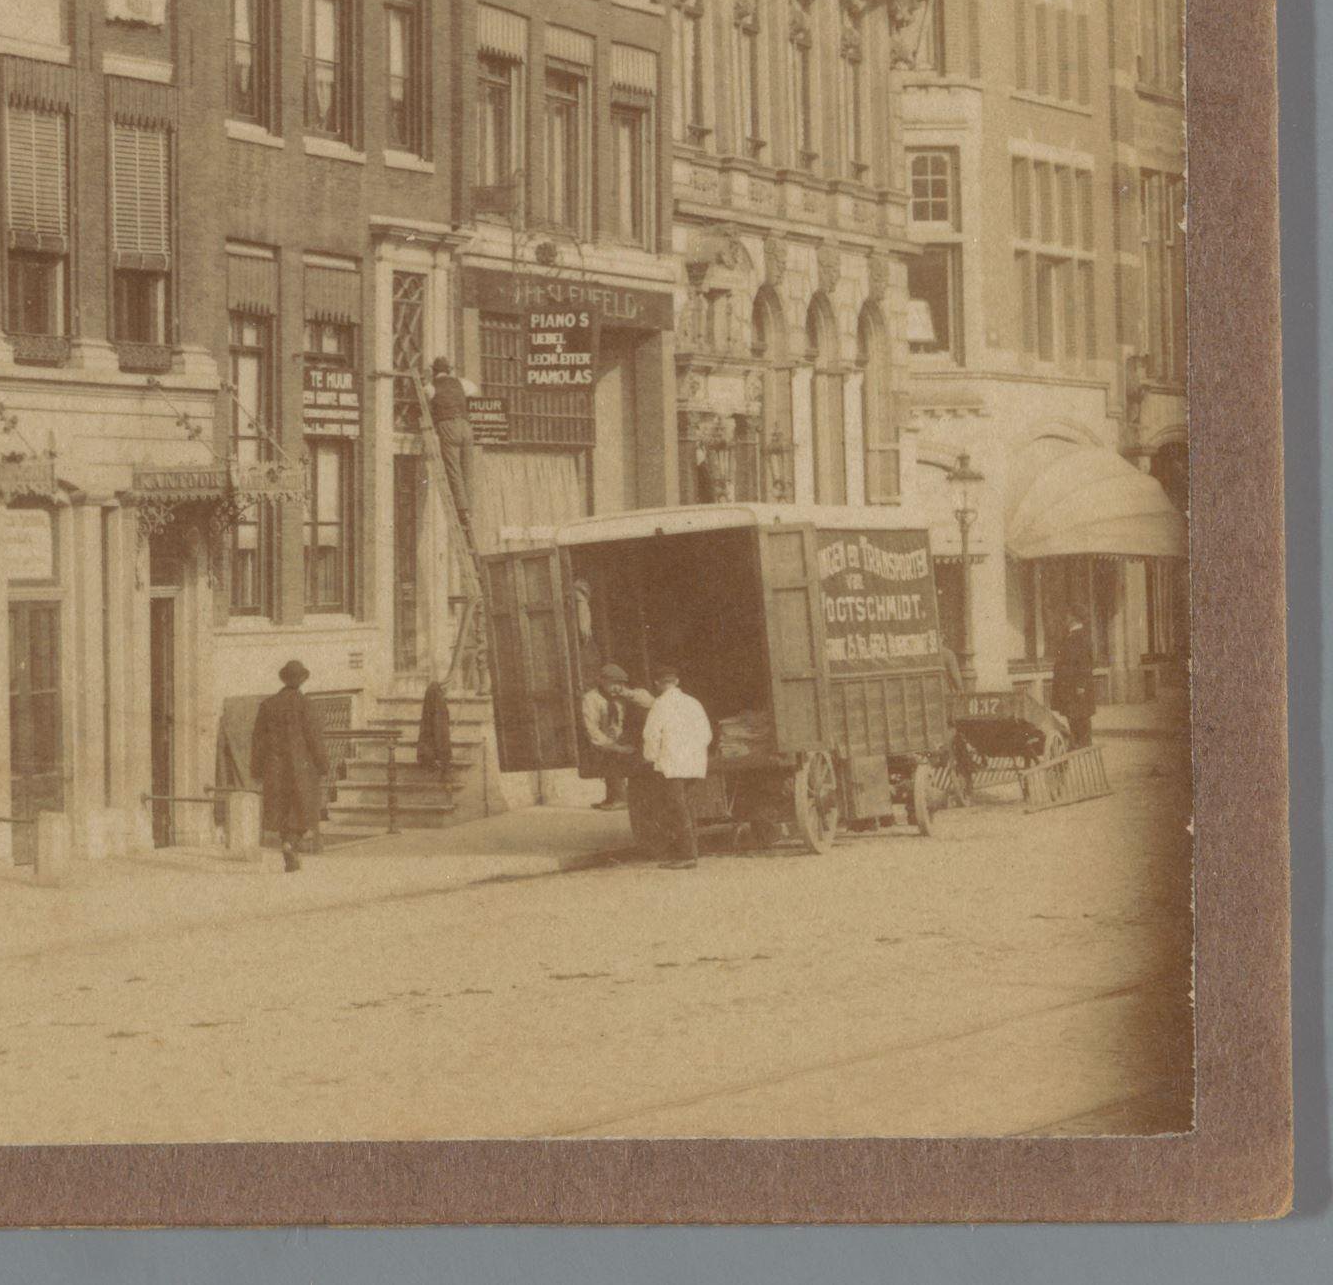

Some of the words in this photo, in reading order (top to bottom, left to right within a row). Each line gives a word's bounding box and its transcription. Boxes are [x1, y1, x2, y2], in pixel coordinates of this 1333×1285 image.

[309, 370, 324, 388] TE
[326, 371, 353, 389] HUUR
[527, 370, 593, 385] PIANOLAS
[469, 400, 502, 411] HUUR
